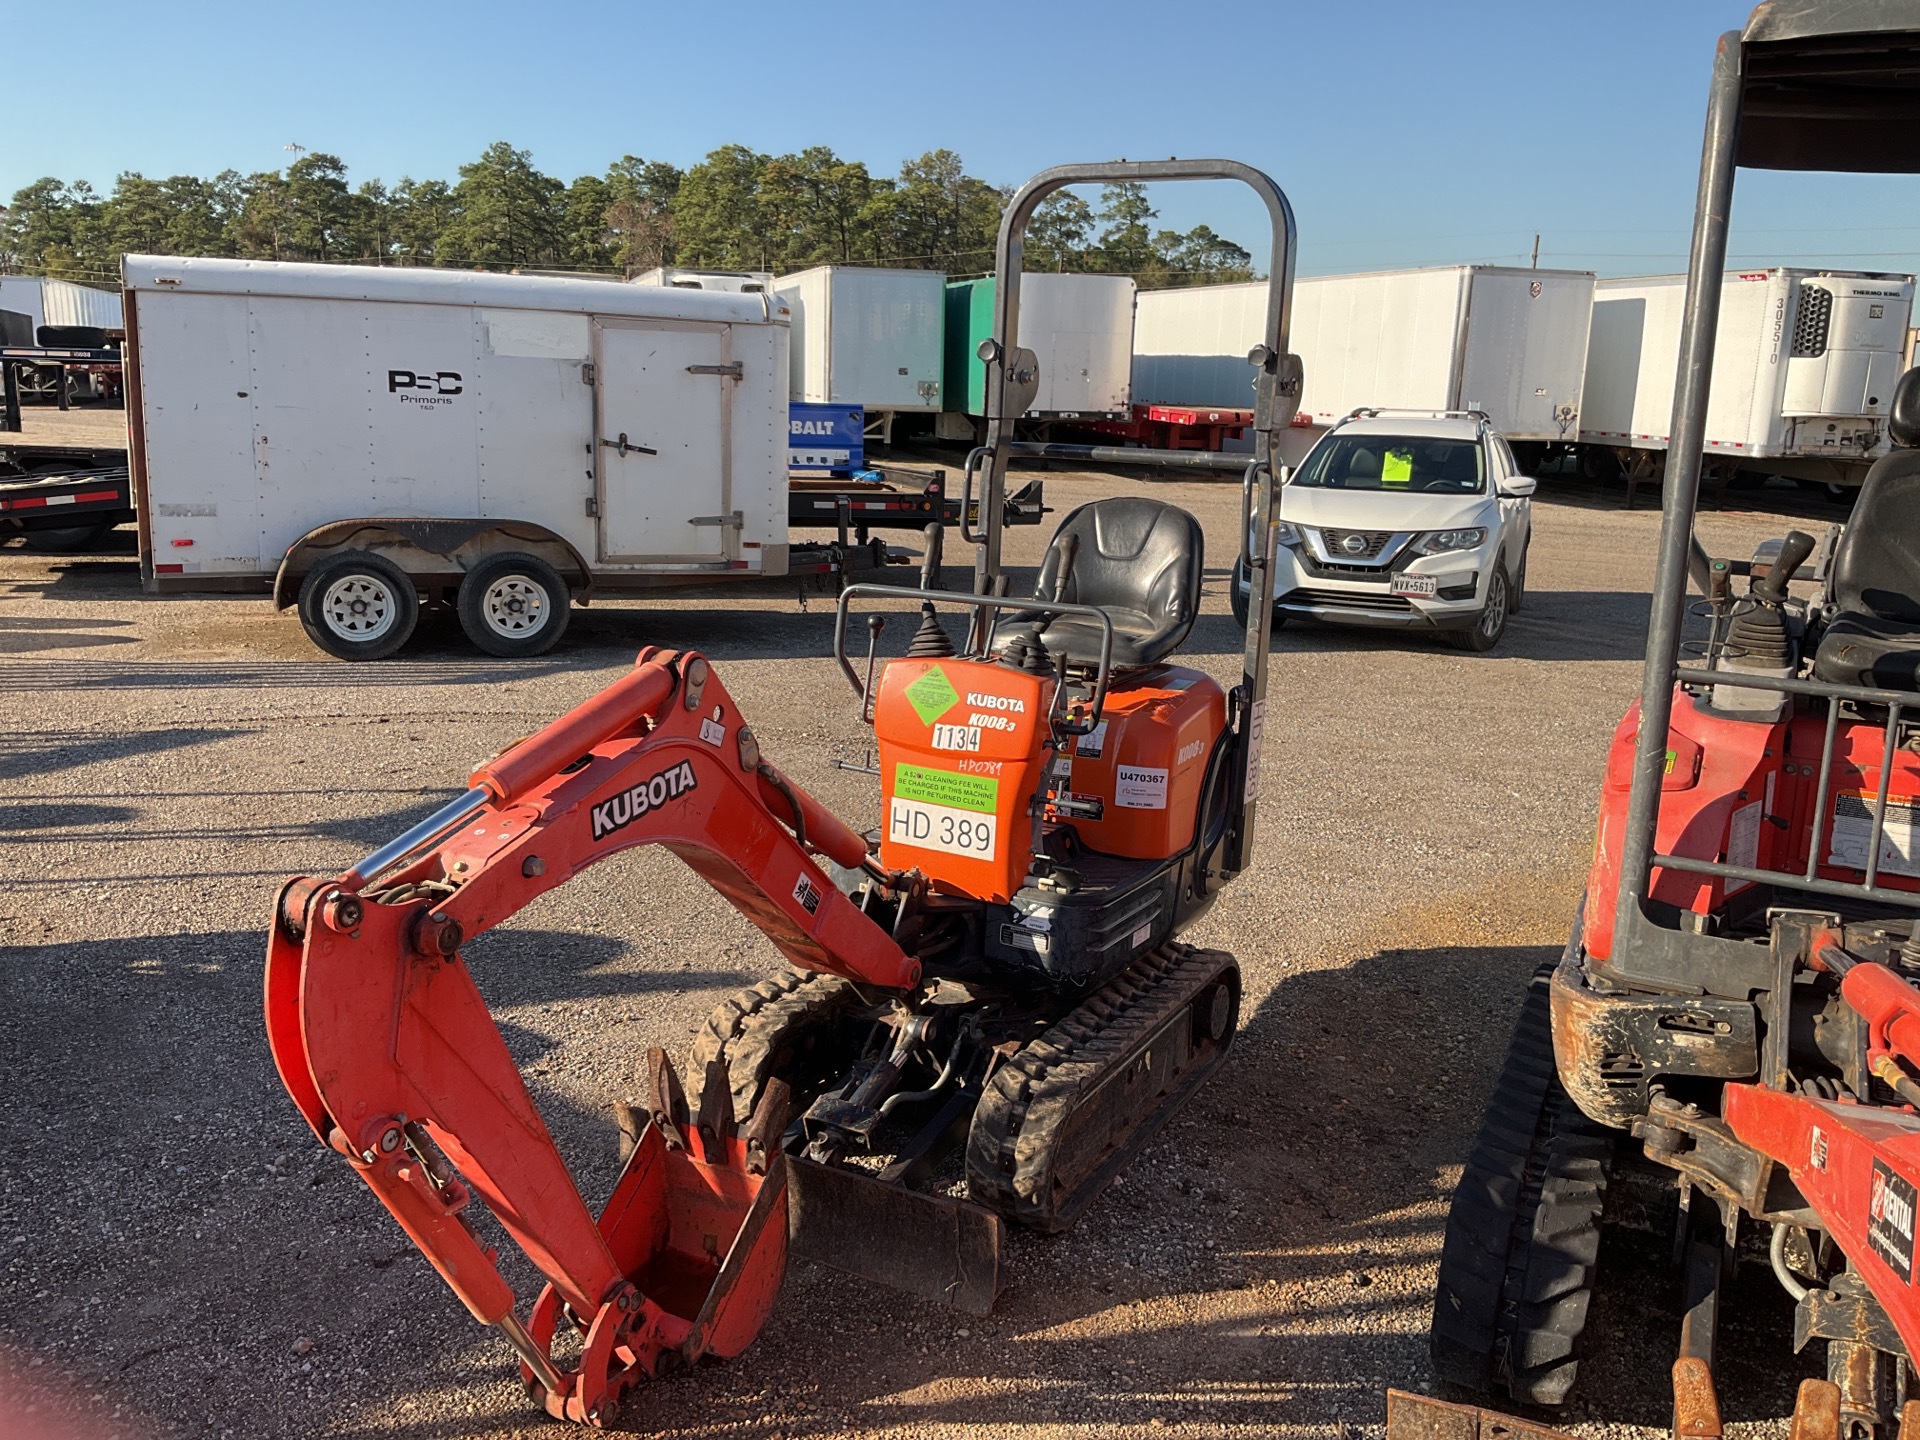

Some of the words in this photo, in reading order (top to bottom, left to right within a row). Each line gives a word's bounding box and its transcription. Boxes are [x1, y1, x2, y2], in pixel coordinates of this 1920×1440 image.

[400, 395, 453, 405] Primoris
[788, 420, 834, 435] BALT
[966, 692, 1025, 713] KUBOTA
[968, 713, 1016, 732] K008-3
[1252, 701, 1264, 740] HD
[935, 726, 978, 751] 1134
[925, 774, 958, 785] CLEANING
[959, 780, 971, 788] FEE
[973, 782, 989, 790] WILL
[1120, 771, 1165, 783] U470367
[1247, 749, 1259, 797] 389
[898, 777, 907, 785] BE
[908, 779, 939, 791] CHARGED
[948, 786, 962, 795] THIS
[963, 789, 994, 800] MACHINE
[912, 788, 925, 796] NOT
[927, 790, 962, 803] RETURNED
[962, 797, 985, 807] CLEAN
[592, 762, 696, 838] KUBOTA
[892, 806, 931, 839] HD
[939, 815, 991, 852] 389
[1883, 1186, 1912, 1241] RENTAL
